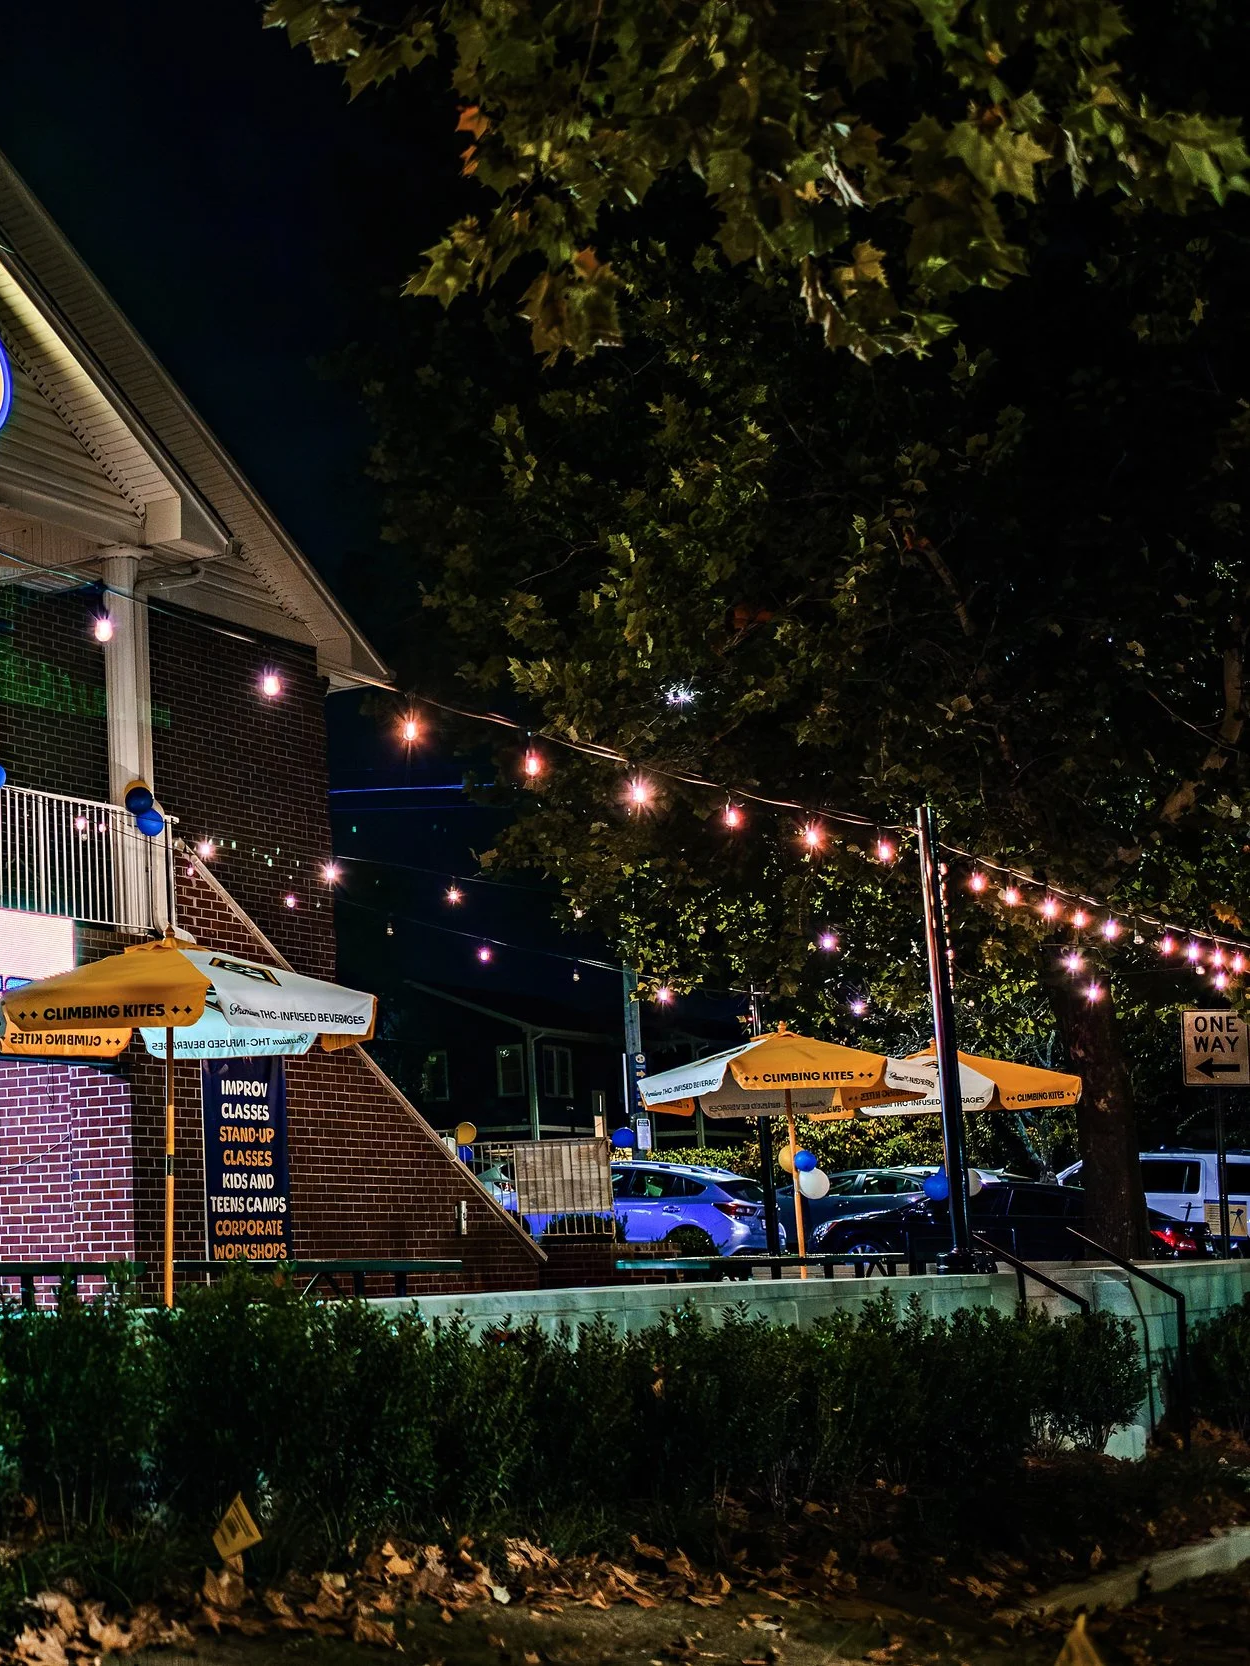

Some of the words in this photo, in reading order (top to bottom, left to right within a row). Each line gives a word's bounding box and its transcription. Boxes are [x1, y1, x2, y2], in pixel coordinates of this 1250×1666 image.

[43, 1004, 120, 1021] CLIMBING
[123, 1003, 166, 1018] KITES
[260, 1009, 318, 1023] THC-INFUSED
[318, 1012, 366, 1025] BEVERAGES
[1194, 1016, 1238, 1033] ONE
[1193, 1036, 1240, 1053] WAY
[762, 1071, 820, 1083] CLIMBING
[823, 1071, 854, 1081] KITES
[221, 1079, 268, 1098] IMPROV
[1016, 1091, 1048, 1102] CLIMBING
[1048, 1090, 1065, 1100] KITES
[221, 1102, 270, 1121] CLASSES
[219, 1126, 275, 1144] STAND-UP
[223, 1150, 273, 1167] CLASSES
[222, 1172, 248, 1190] KIDS
[249, 1173, 274, 1190] AND
[210, 1195, 245, 1213] TEENS
[246, 1196, 287, 1213] CAMPS
[215, 1219, 283, 1236] CORPORATE
[213, 1242, 287, 1260] WORKSHOPS
